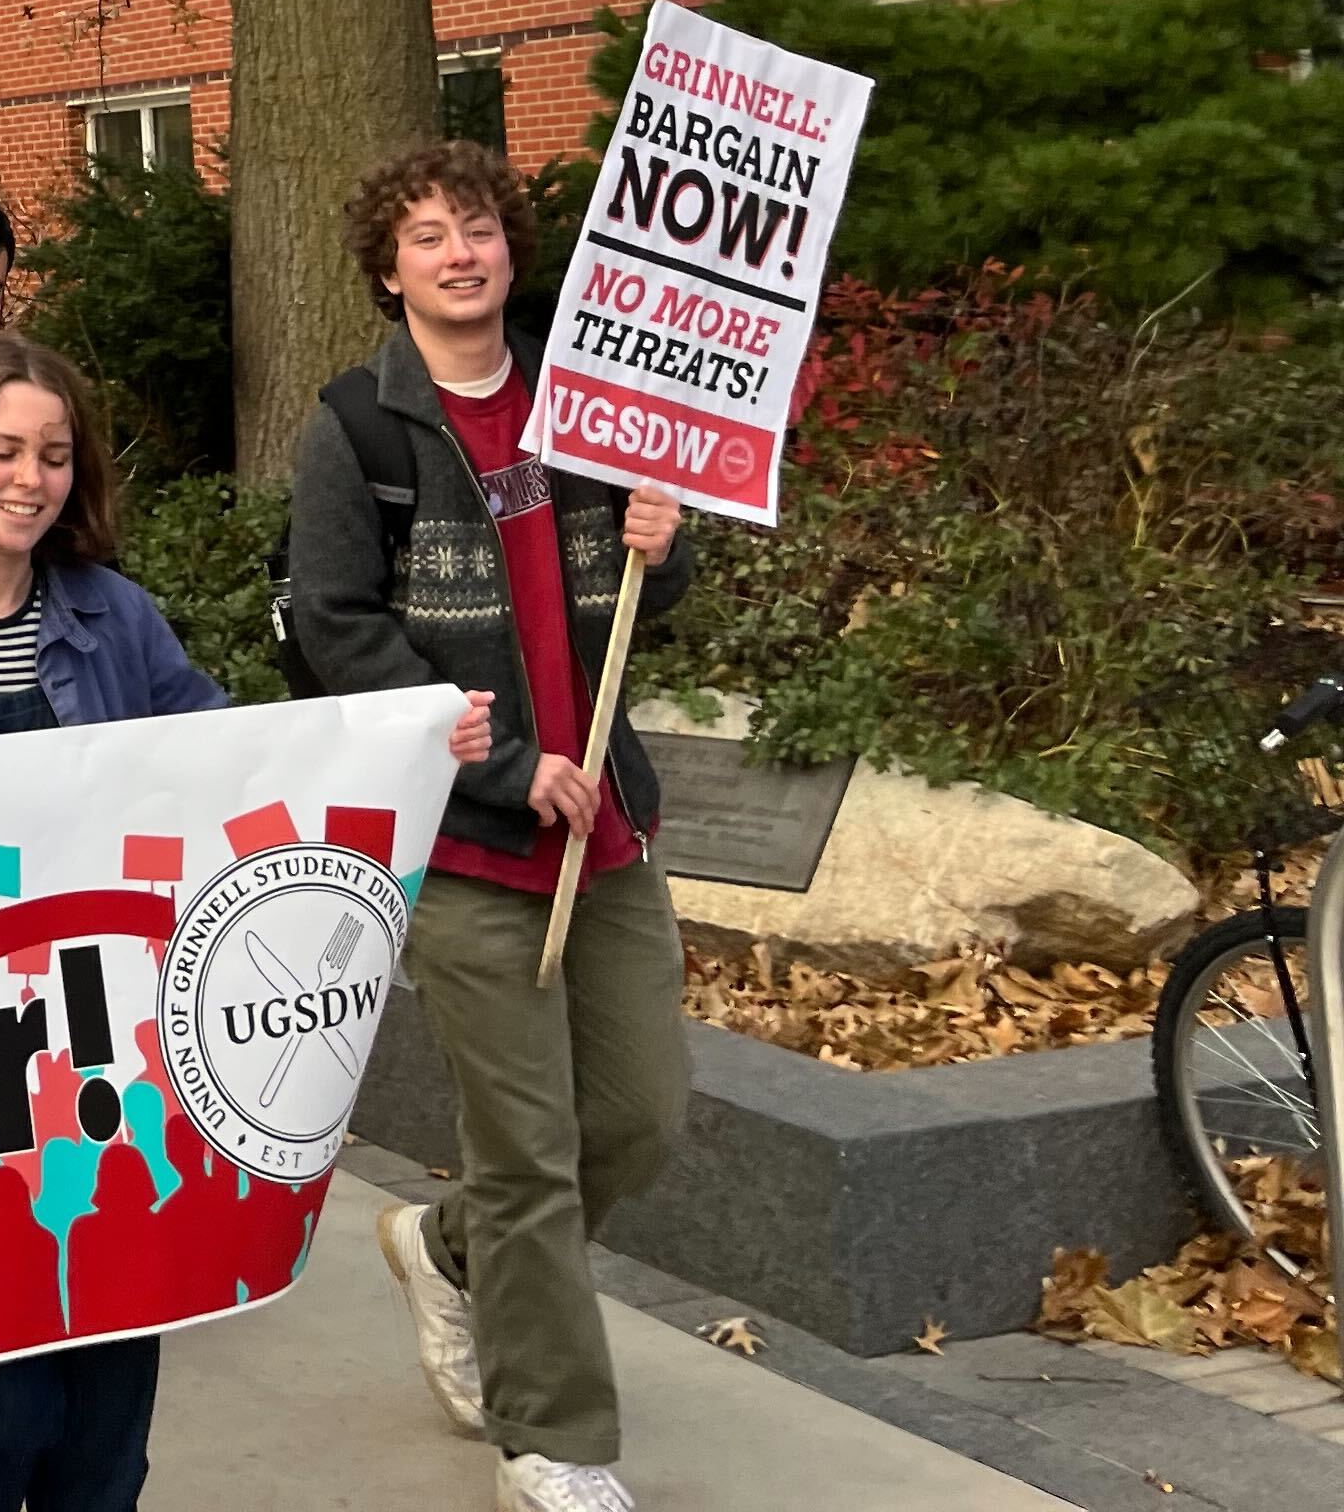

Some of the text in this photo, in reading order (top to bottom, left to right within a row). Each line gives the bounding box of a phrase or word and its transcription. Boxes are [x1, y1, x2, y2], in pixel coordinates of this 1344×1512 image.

[645, 41, 833, 143] GRINNELL:
[625, 92, 821, 199] BARGAIN
[608, 146, 810, 281] NOW!
[581, 263, 782, 357] NO MORE
[571, 310, 770, 405] THREATS!
[551, 386, 721, 475] UGSDW
[253, 857, 366, 886] STUDENT
[173, 878, 251, 993] GRINNELL
[170, 1003, 189, 1037] OF
[220, 975, 383, 1046] UGSDW
[176, 1046, 227, 1130] UNION
[261, 1145, 302, 1169] EST
